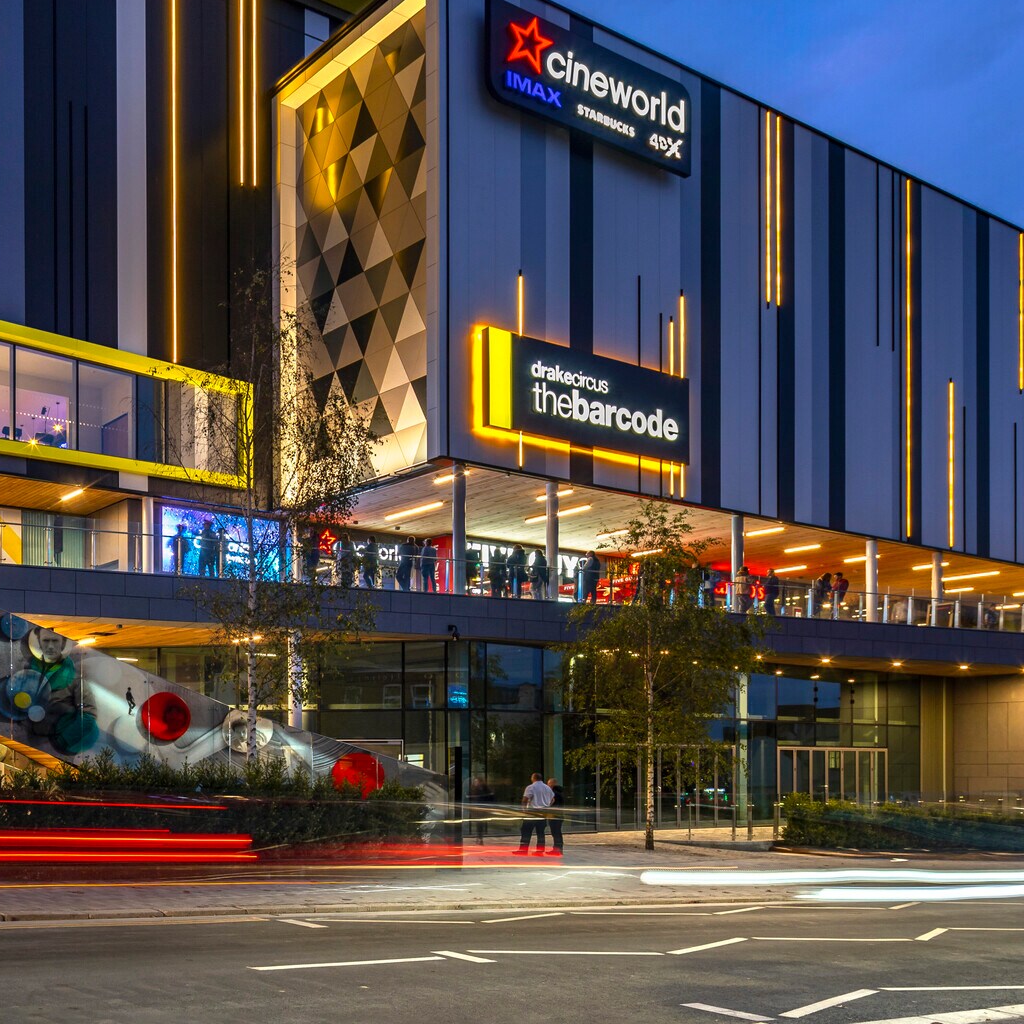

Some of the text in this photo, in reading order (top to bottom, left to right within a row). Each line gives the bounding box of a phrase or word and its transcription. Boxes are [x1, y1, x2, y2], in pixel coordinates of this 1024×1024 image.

[506, 70, 562, 108] IMAX
[546, 51, 685, 133] cineworld
[577, 104, 635, 137] STARBUCKS
[649, 133, 683, 159] 4DX
[531, 360, 608, 394] drakecircus
[532, 382, 679, 441] thebarcode
